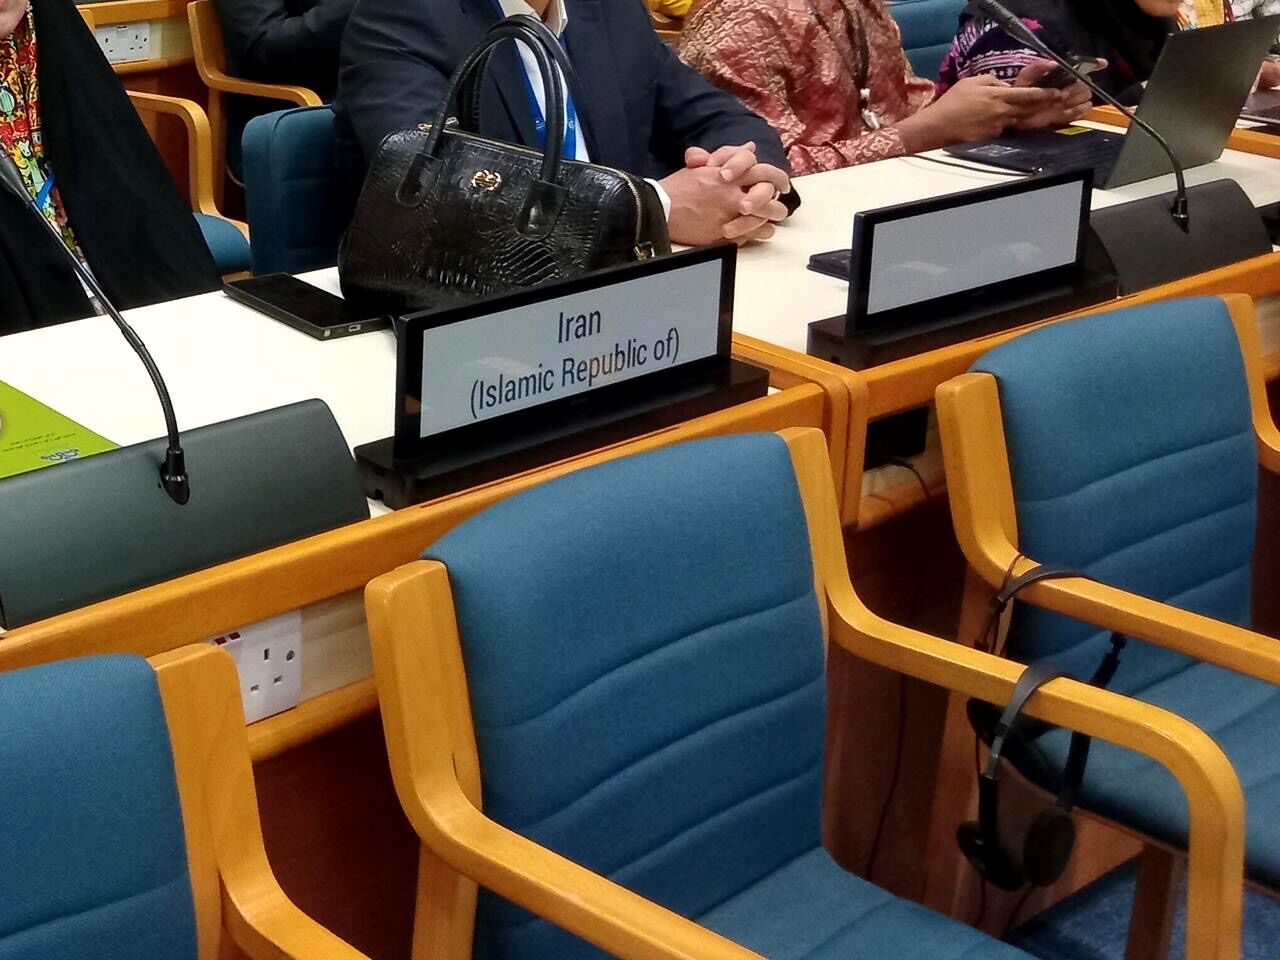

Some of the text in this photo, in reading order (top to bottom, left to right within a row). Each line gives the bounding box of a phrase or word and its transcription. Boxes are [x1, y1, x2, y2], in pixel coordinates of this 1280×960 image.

[558, 309, 602, 344] Iran
[470, 327, 680, 420] (Islamic Republic of)
